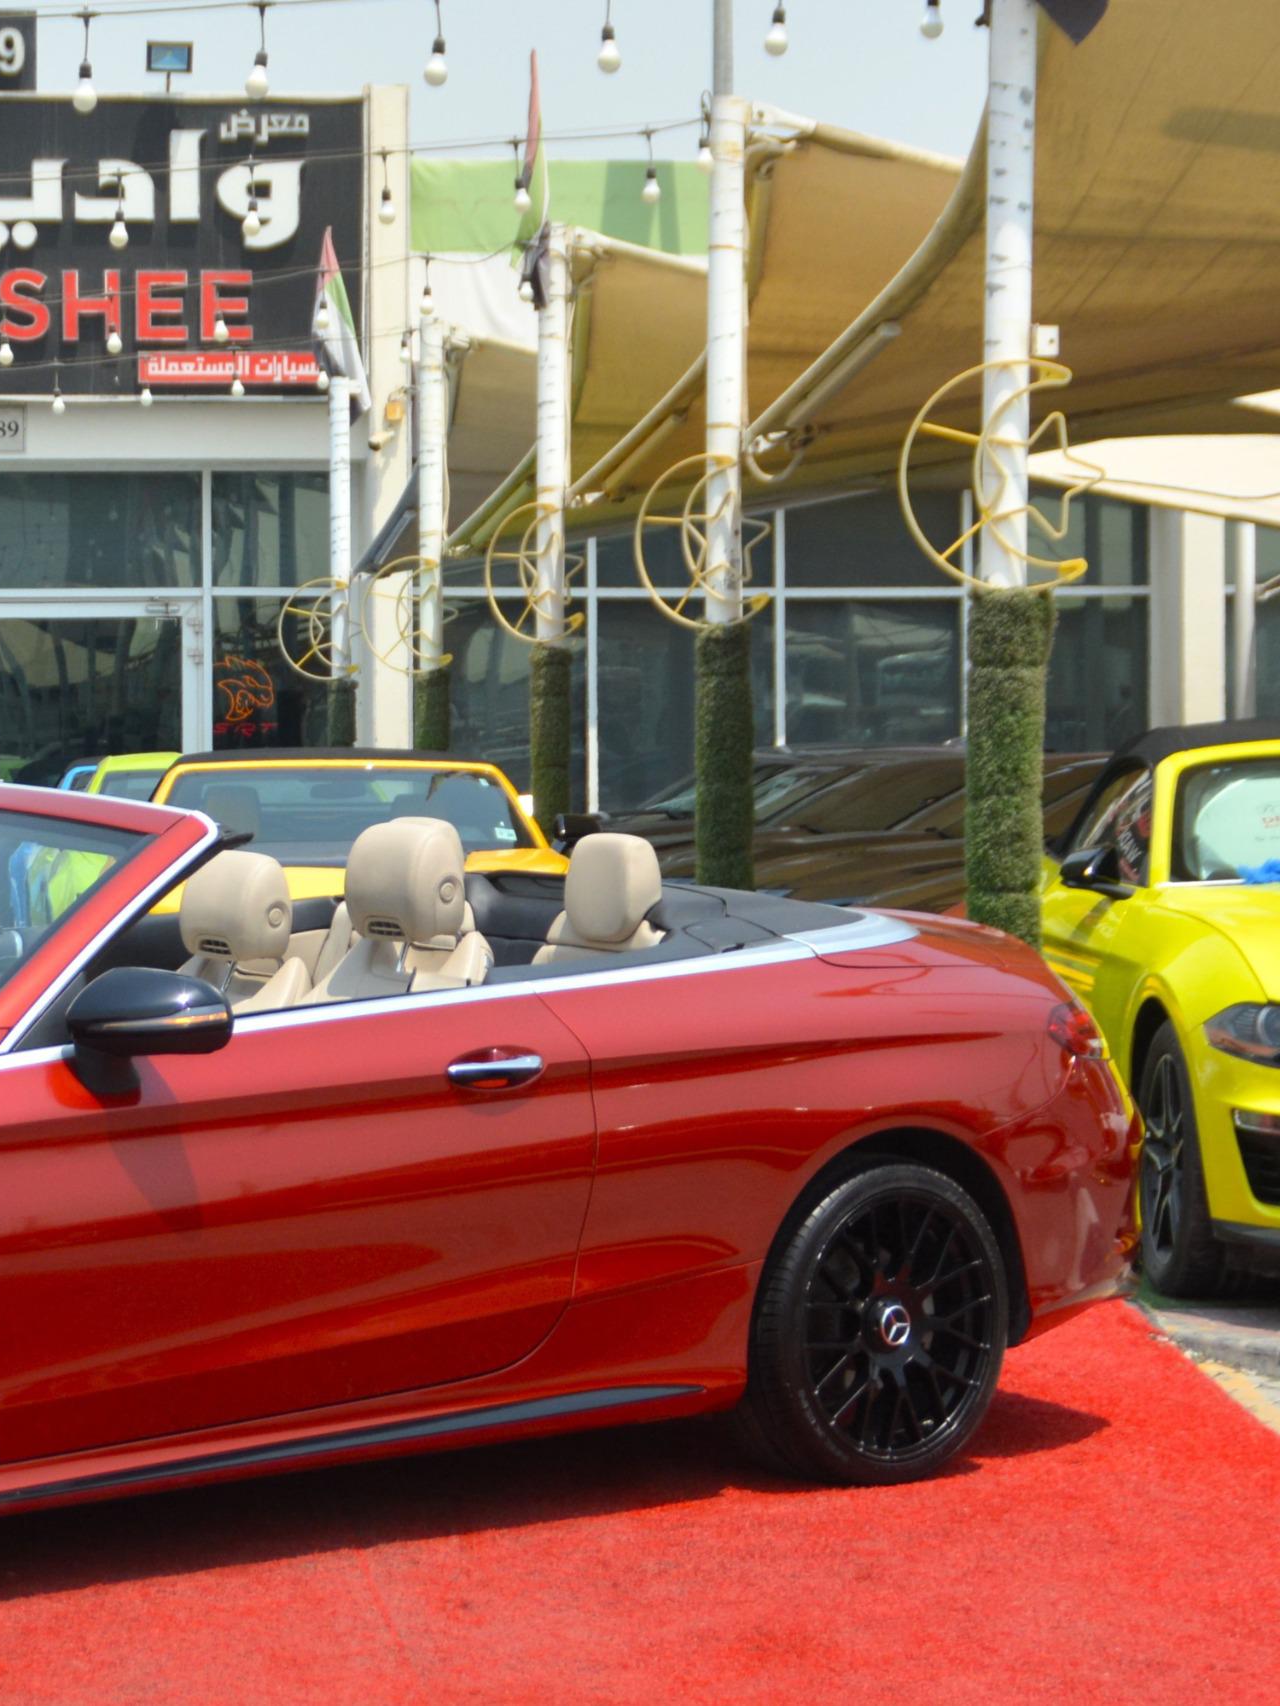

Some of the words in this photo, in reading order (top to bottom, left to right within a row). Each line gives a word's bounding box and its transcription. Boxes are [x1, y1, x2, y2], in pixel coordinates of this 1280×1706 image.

[220, 109, 310, 144] معرض
[148, 355, 250, 376] المستعملة
[255, 355, 320, 382] سيارات
